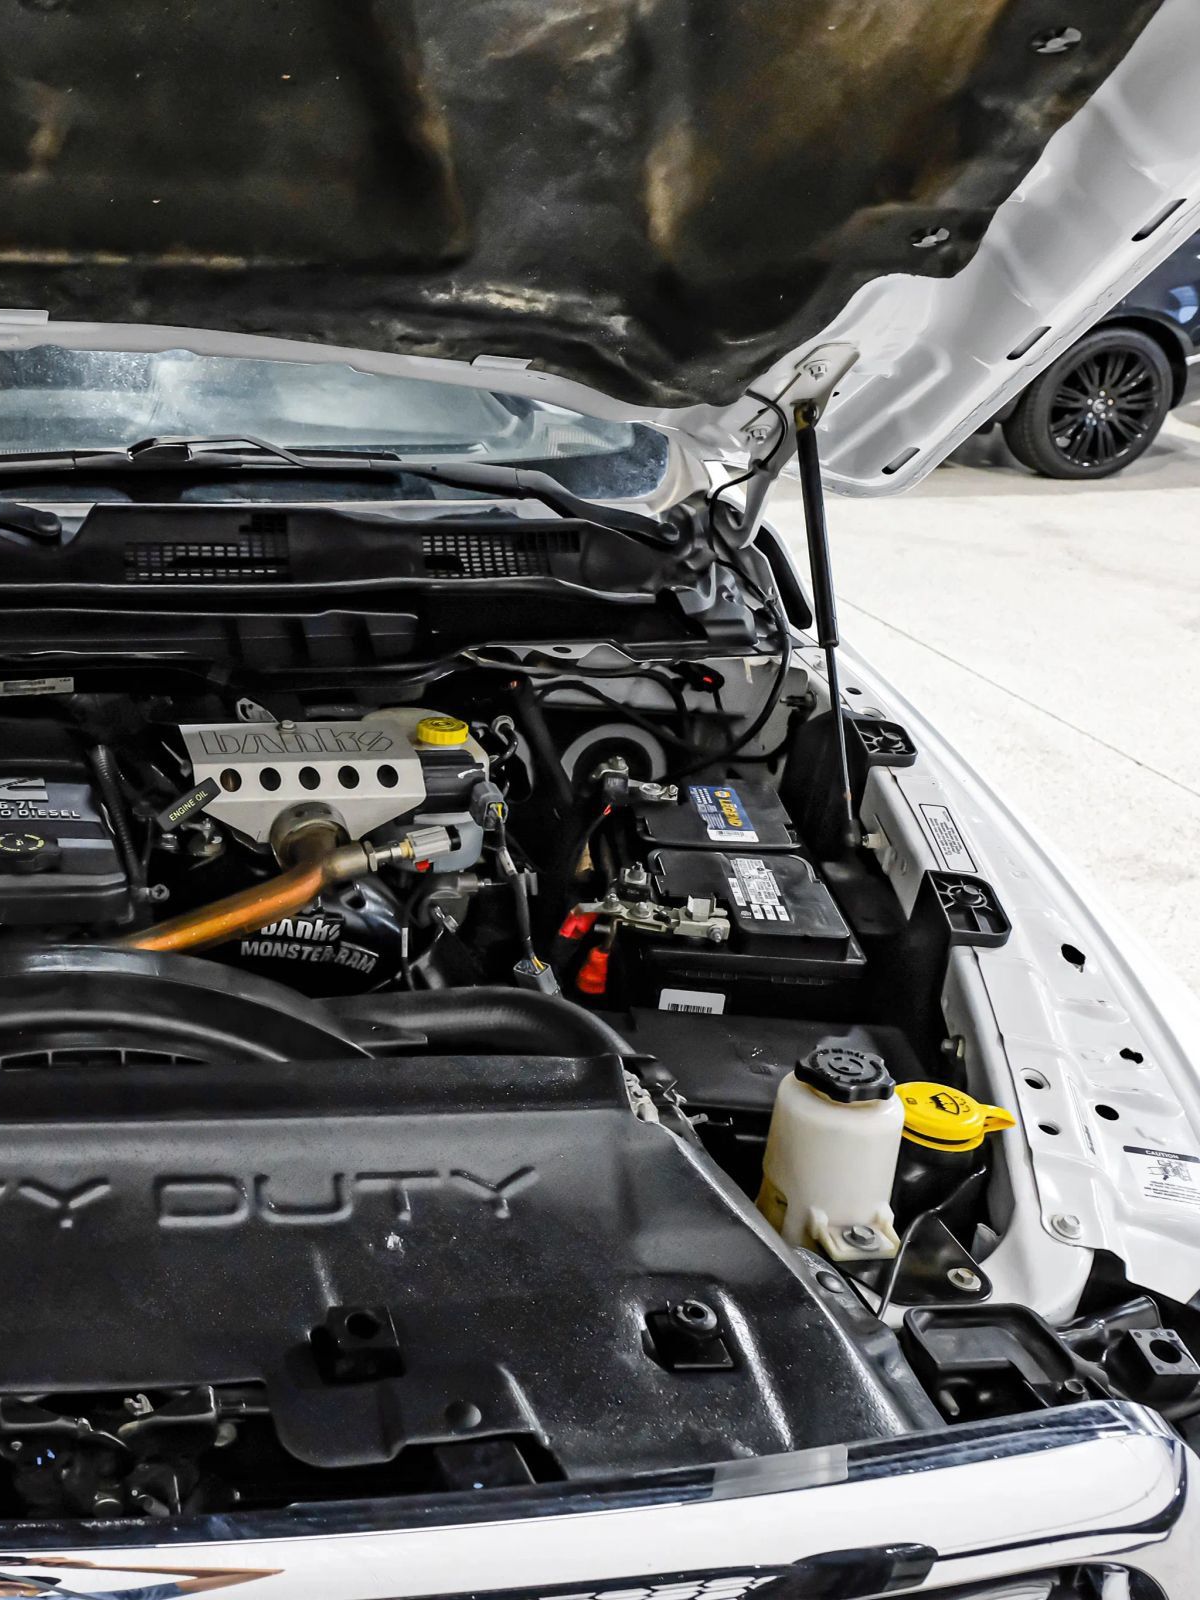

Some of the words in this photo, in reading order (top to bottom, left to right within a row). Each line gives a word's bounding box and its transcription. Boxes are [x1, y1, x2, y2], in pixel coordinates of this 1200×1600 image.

[19, 809, 81, 818] DIESEL
[169, 798, 196, 821] ENGINE
[195, 790, 208, 801] OIL
[1145, 1149, 1180, 1160] CAUTION
[153, 1164, 541, 1228] DUTY
